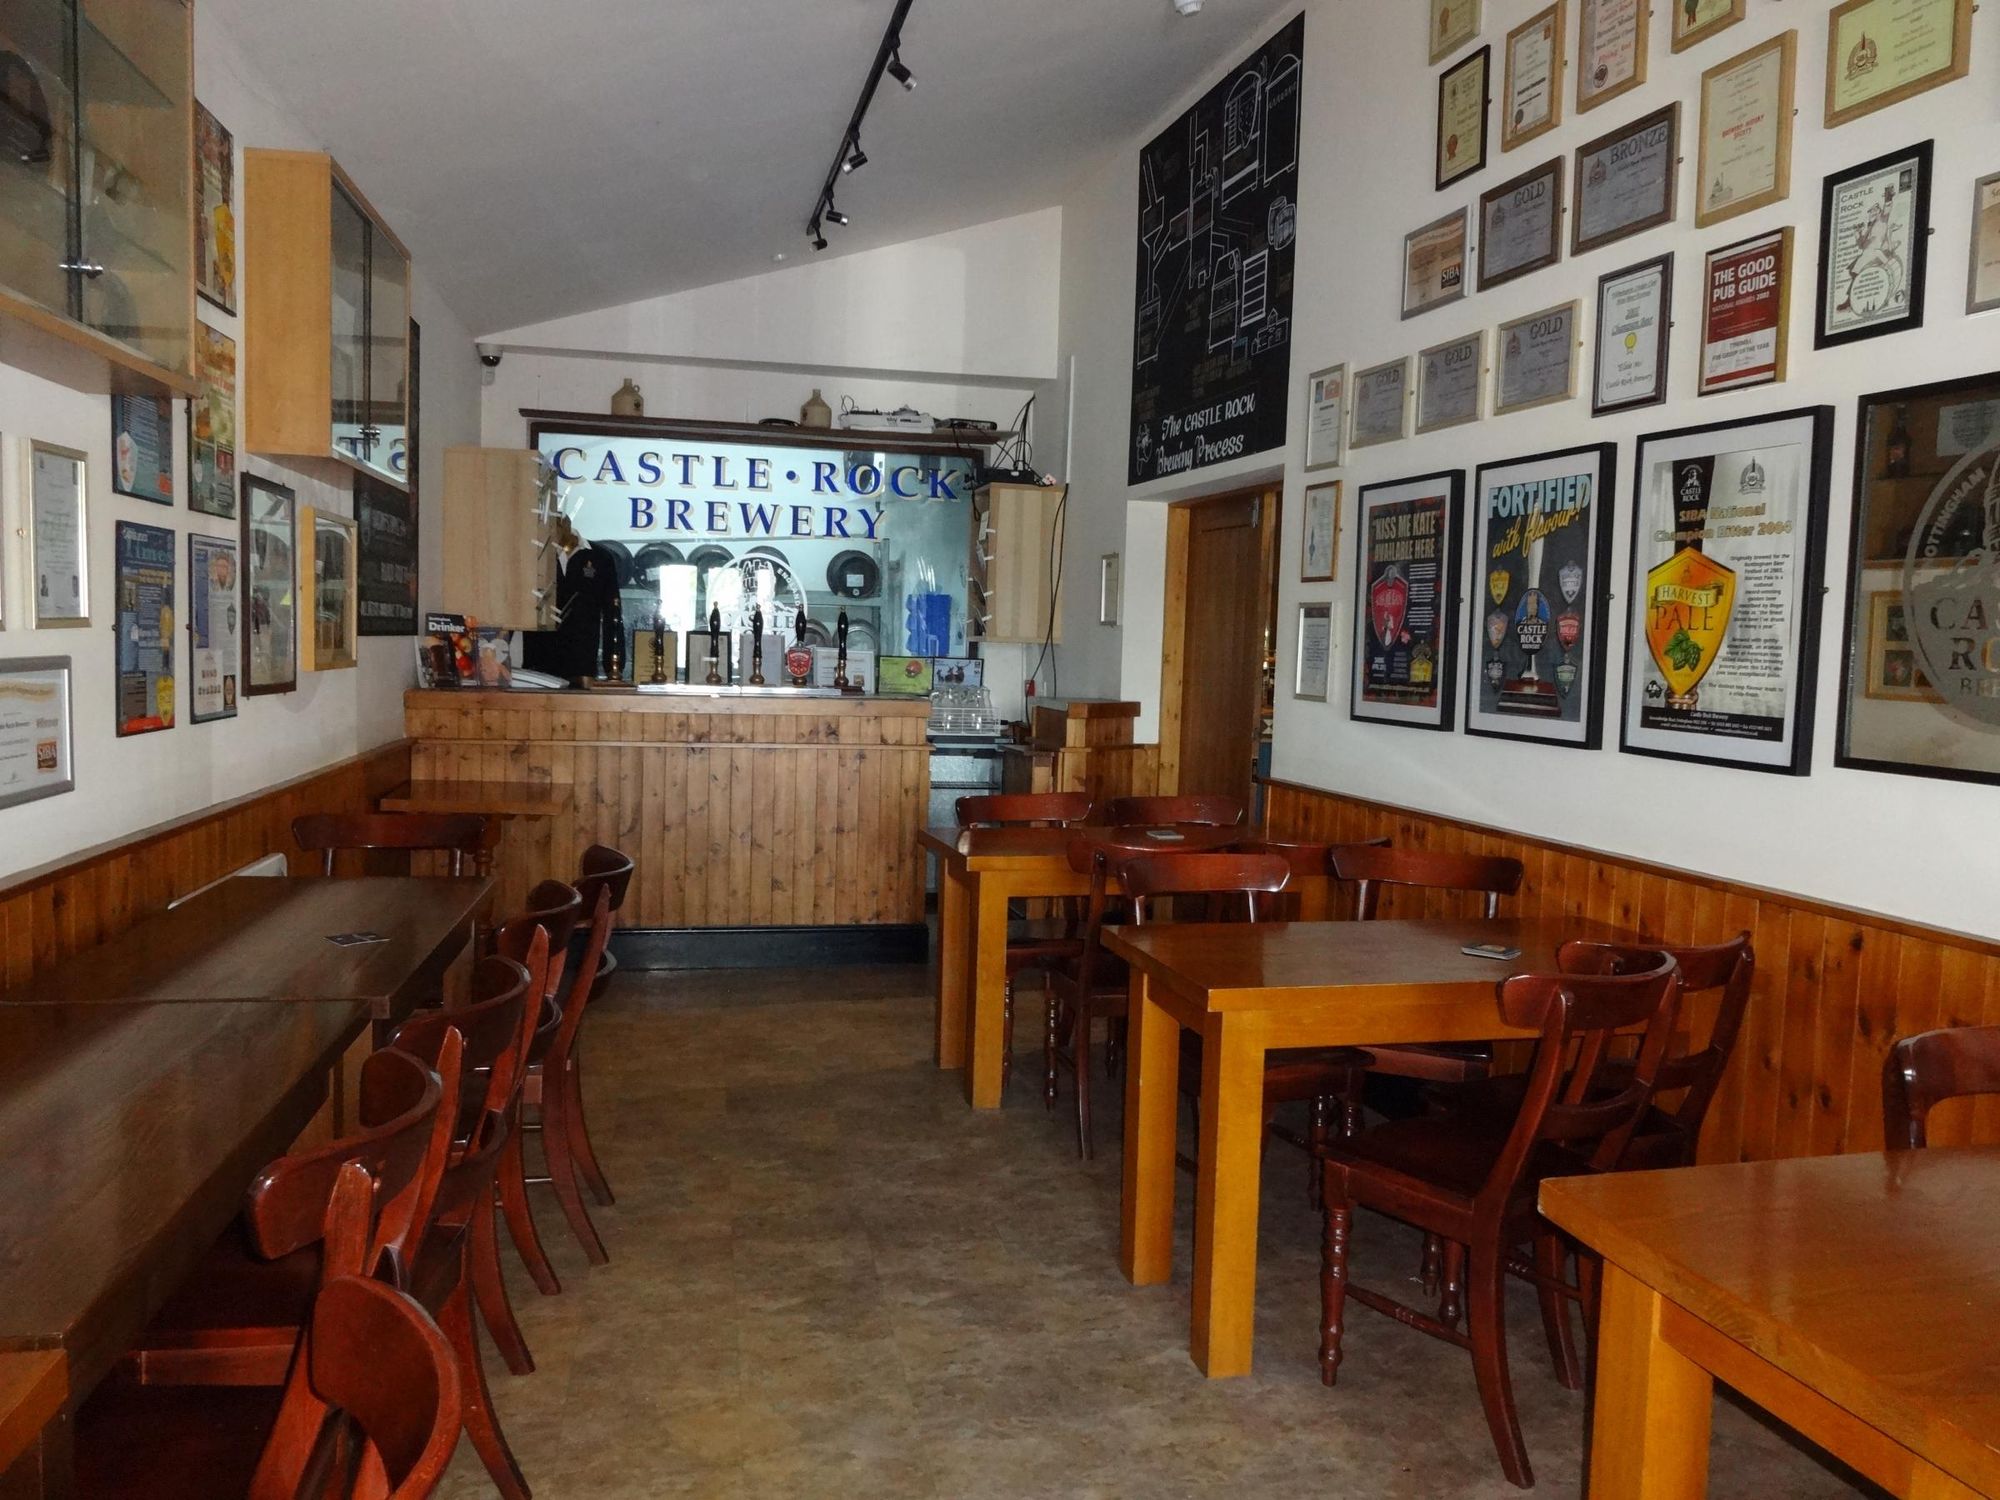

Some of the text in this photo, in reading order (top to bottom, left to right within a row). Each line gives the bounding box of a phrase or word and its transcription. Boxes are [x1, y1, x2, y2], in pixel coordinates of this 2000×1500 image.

[1610, 126, 1667, 165] BRONZE
[1514, 181, 1545, 209] GOLD
[1841, 187, 1874, 203] CASTLE
[1840, 201, 1865, 214] ROCK
[1442, 266, 1460, 282] SIBA
[1713, 255, 1776, 286] THE GOOD
[1712, 271, 1777, 303] PUB GUIDE
[1530, 316, 1563, 340] GOLD
[1444, 345, 1472, 366] GOLD
[1375, 369, 1400, 387] GOLD
[1161, 393, 1255, 440] The CASTLE ROCK
[1156, 434, 1244, 475] Brewing Process
[552, 447, 958, 501] CASTLE ROCK
[1488, 474, 1592, 519] FORTIFIED
[1680, 487, 1702, 496] CASTLE
[629, 496, 887, 541] BREWERY
[1679, 503, 1767, 522] SIBA National
[1924, 467, 1986, 558] OTTINGHAM
[1397, 513, 1412, 537] ME
[1492, 516, 1521, 558] with
[1654, 527, 1714, 543] Champion
[1717, 523, 1755, 539] Bitter
[1374, 537, 1436, 562] AVAILABLE HERE
[1661, 586, 1711, 605] HARVEST
[428, 621, 465, 633] Drinker
[1517, 625, 1547, 634] CASTLE
[1654, 605, 1714, 631] PALE
[1520, 634, 1543, 644] ROCK
